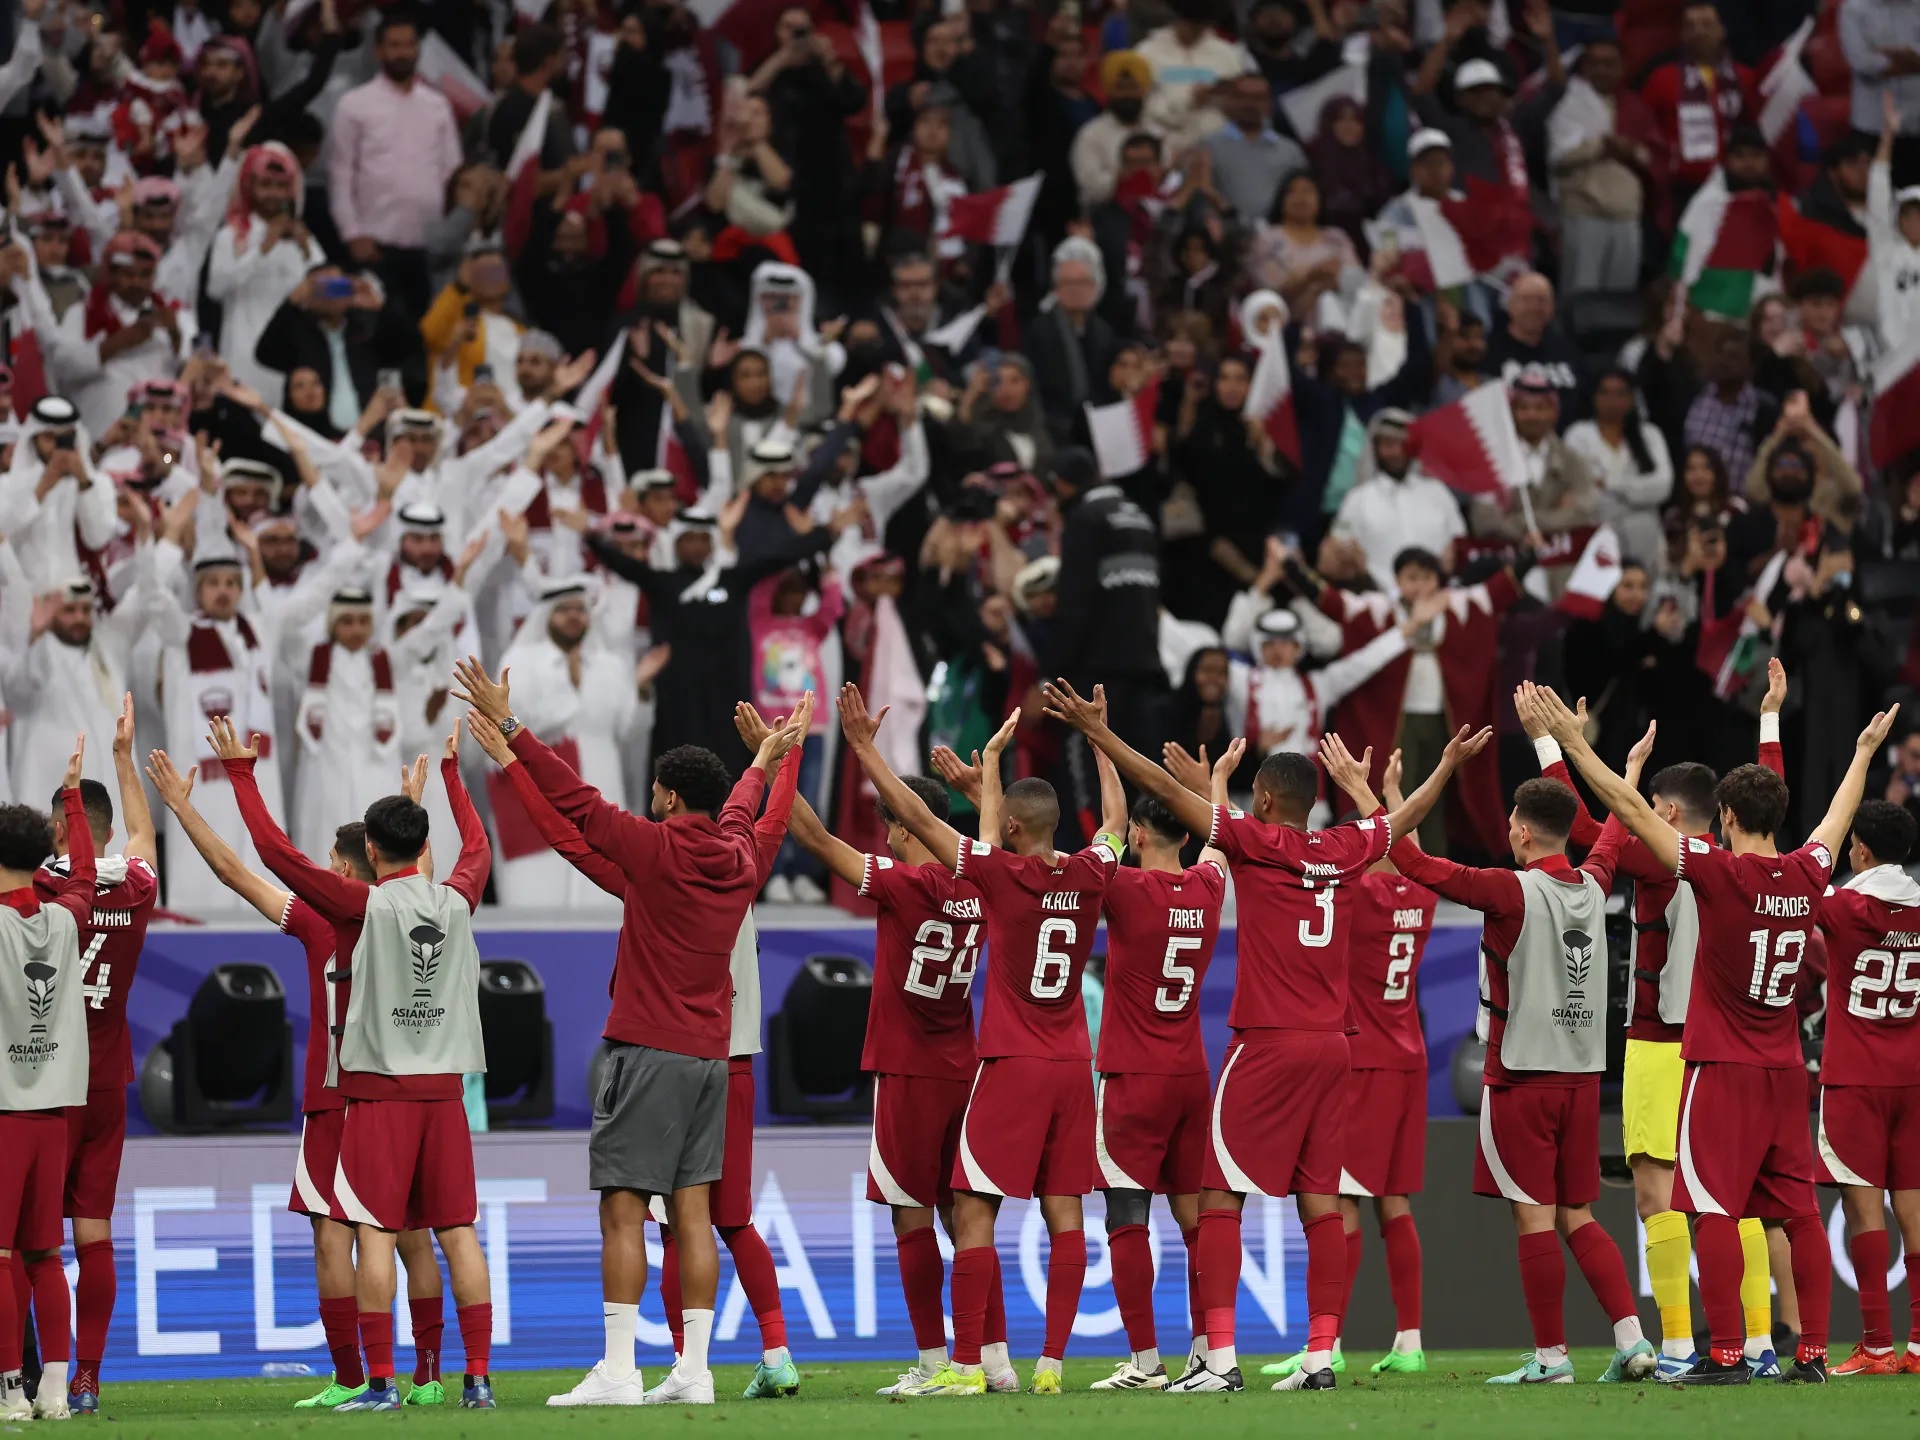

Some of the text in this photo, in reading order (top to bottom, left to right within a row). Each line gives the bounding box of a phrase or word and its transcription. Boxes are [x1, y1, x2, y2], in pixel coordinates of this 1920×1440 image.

[1041, 891, 1081, 911] A.AZIZ
[1298, 876, 1340, 948] 3
[1754, 894, 1810, 917] L.MENDES
[1168, 907, 1205, 929] TAREK
[1393, 908, 1424, 929] PEDRO
[903, 919, 981, 1000] 24
[1030, 917, 1077, 999] 6
[1383, 932, 1416, 1001] 2
[1748, 929, 1806, 1007] 12
[1154, 936, 1203, 1012] 5
[1848, 949, 1920, 1020] 25
[392, 1008, 445, 1018] ASIAN CUP
[394, 1018, 422, 1027] QATAR
[1551, 1008, 1594, 1019] ASIAN CU
[1552, 1018, 1577, 1028] QATAR
[7, 1042, 59, 1054] ASIAN CUP
[10, 1054, 39, 1064] QATAR
[64, 1168, 1288, 1356] EDIT AION
